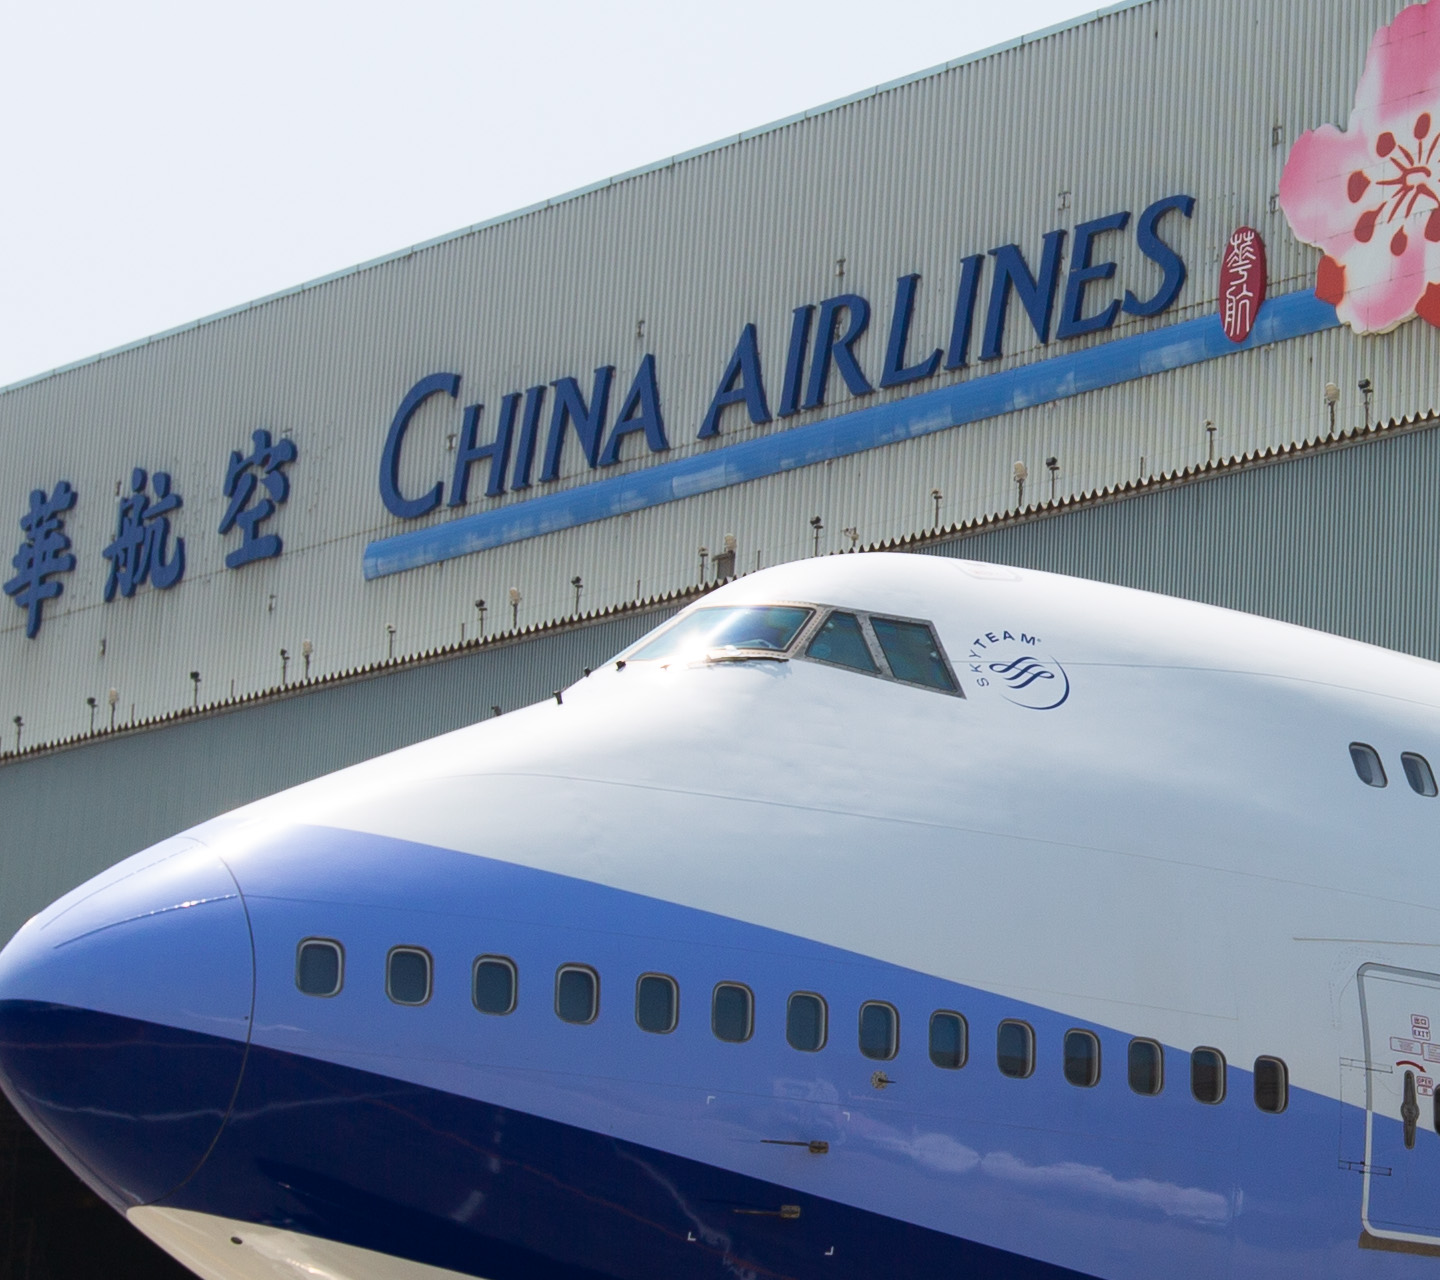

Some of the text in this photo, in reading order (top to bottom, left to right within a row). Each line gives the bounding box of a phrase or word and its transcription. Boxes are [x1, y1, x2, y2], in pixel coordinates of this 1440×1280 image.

[379, 194, 1196, 520] CHINA AIRLINES
[968, 629, 1037, 688] SKYTEAM
[1412, 1028, 1430, 1039] EXIT
